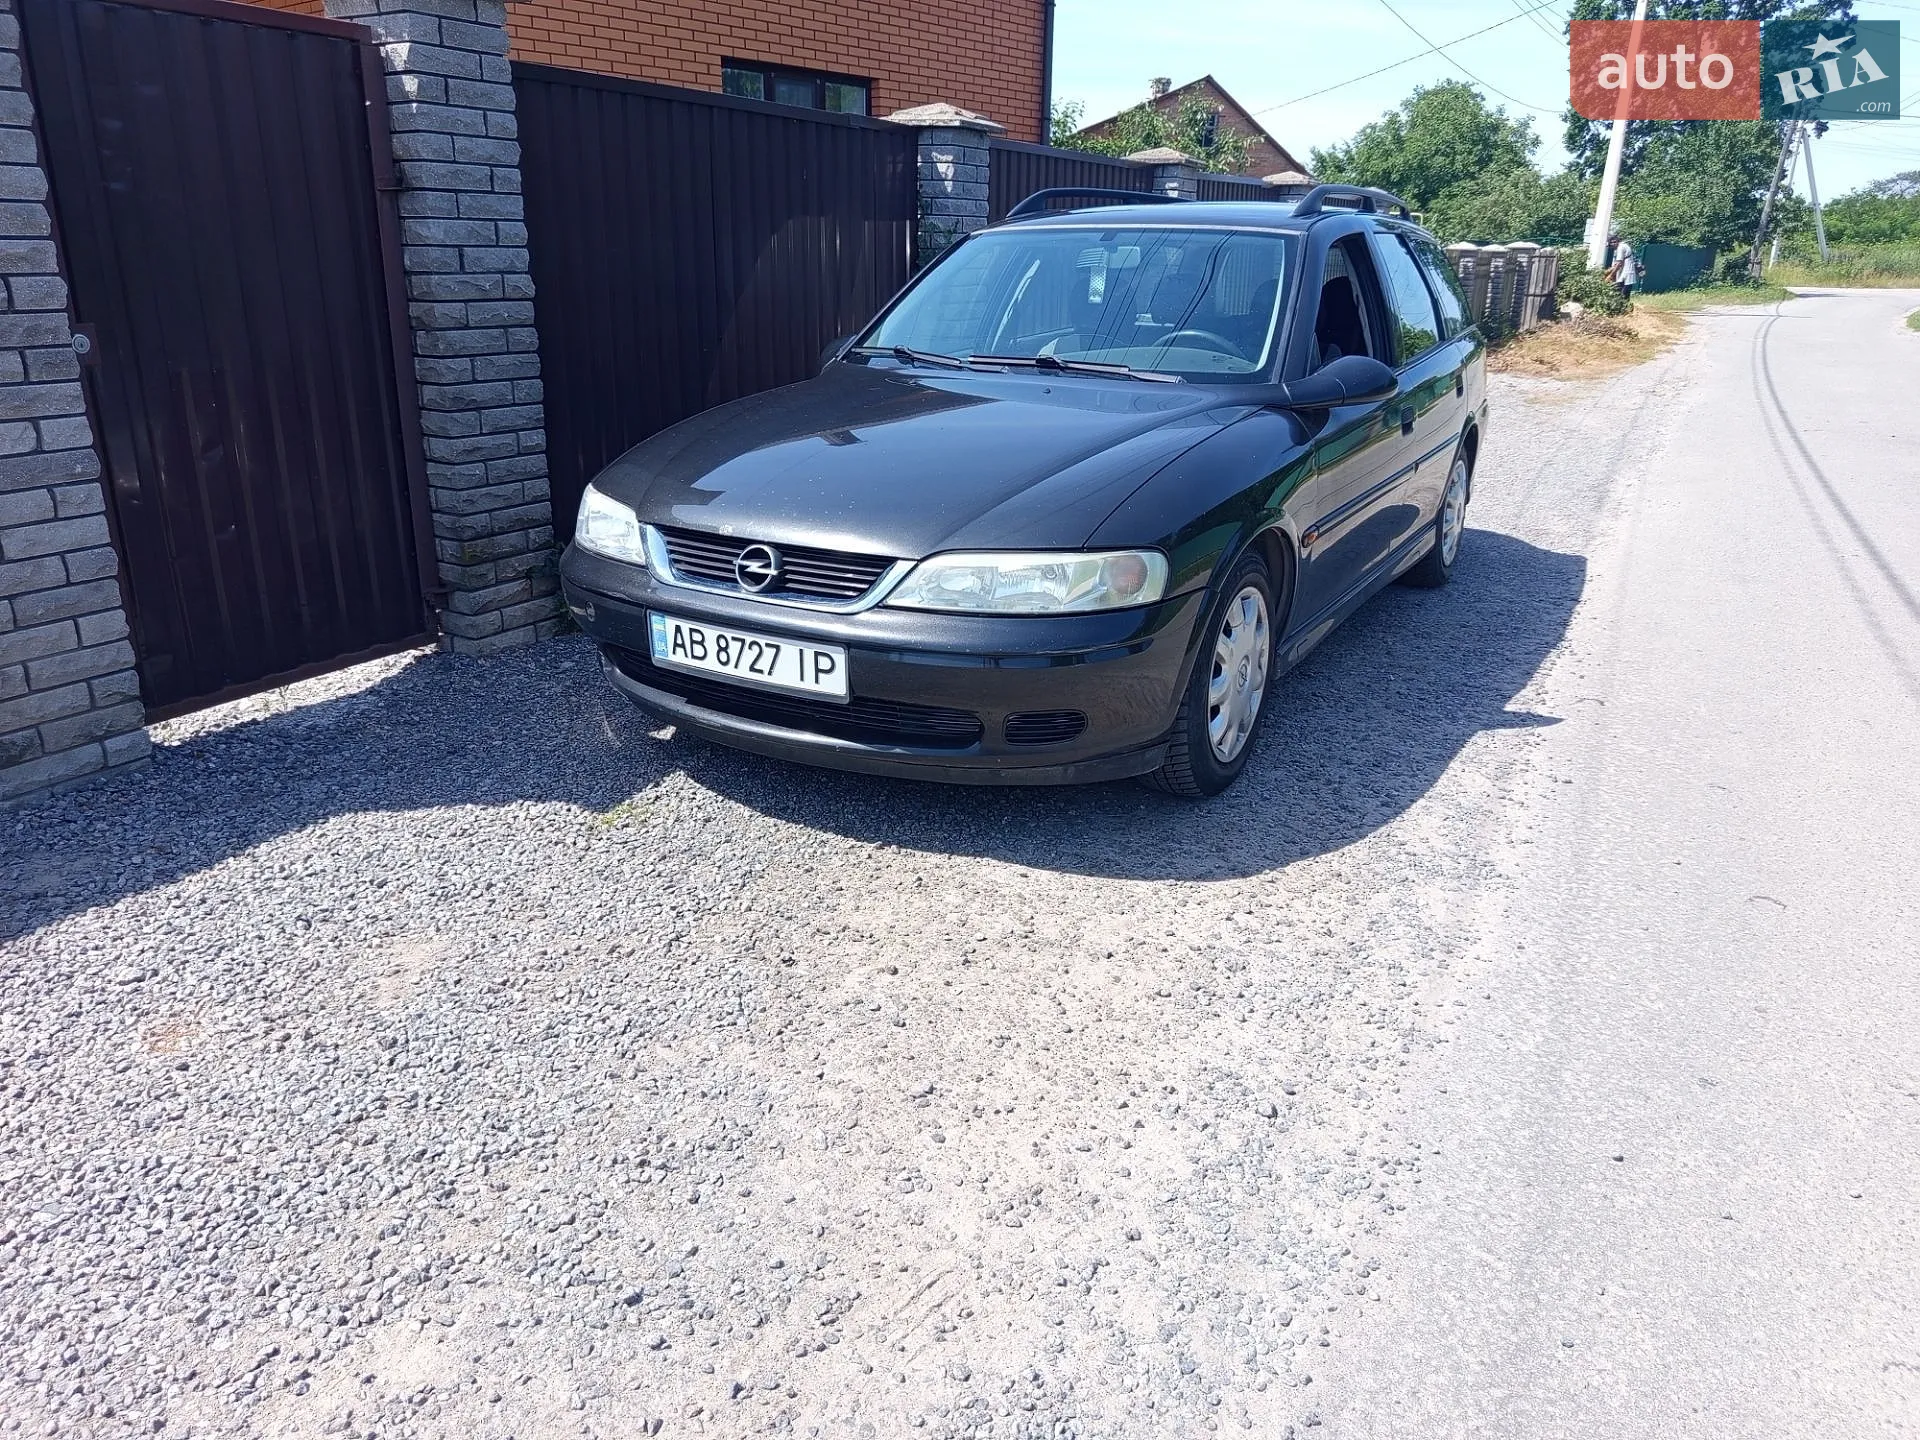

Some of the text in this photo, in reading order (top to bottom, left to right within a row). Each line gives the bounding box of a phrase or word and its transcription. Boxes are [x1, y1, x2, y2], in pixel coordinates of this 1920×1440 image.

[672, 624, 836, 685] AB 8727 IP
